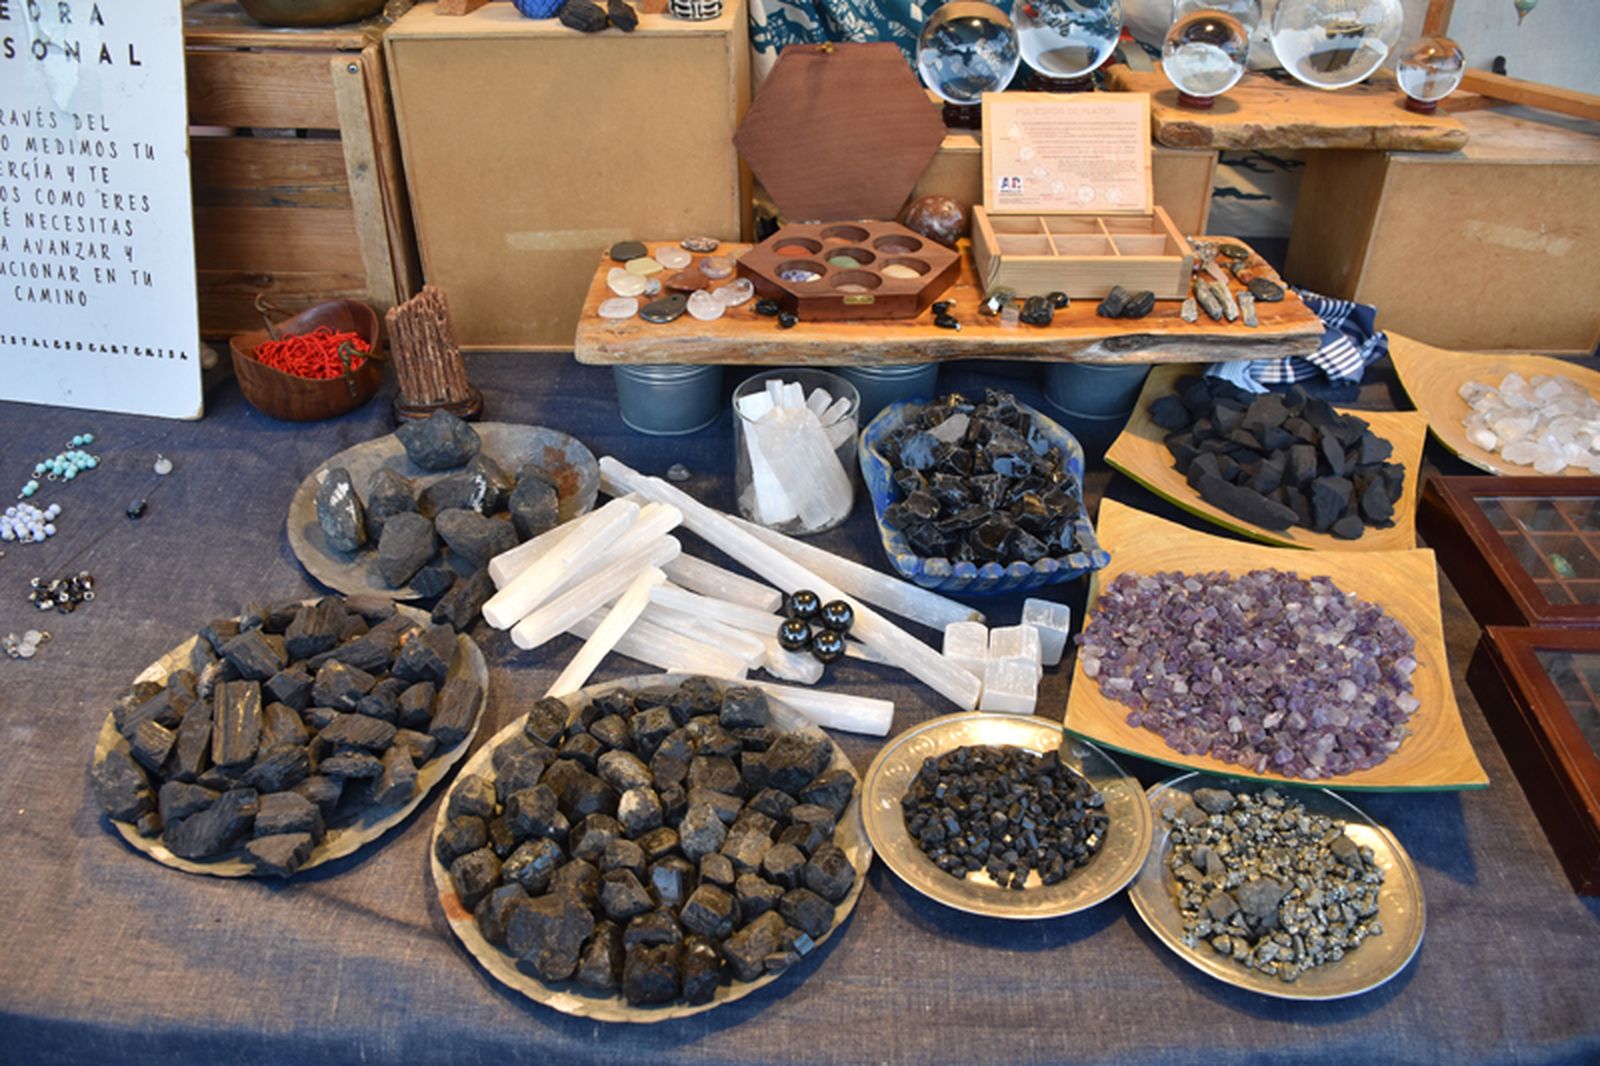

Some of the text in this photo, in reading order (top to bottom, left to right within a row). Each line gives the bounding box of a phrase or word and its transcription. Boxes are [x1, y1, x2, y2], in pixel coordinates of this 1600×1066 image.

[0, 0, 105, 27] EDRA
[2, 36, 143, 67] SONAL
[71, 112, 110, 132] DEL
[25, 136, 118, 160] MEDIMOS
[132, 142, 155, 161] TU
[65, 165, 75, 183] Y
[88, 165, 110, 185] TE
[34, 187, 86, 209] COMO
[100, 191, 151, 213] ERES
[24, 212, 134, 238] NECESITAS
[23, 237, 111, 261] AVANZAR
[124, 245, 133, 263] Y
[94, 266, 117, 285] EN
[130, 269, 153, 288] TU
[14, 284, 88, 308] CAMINO
